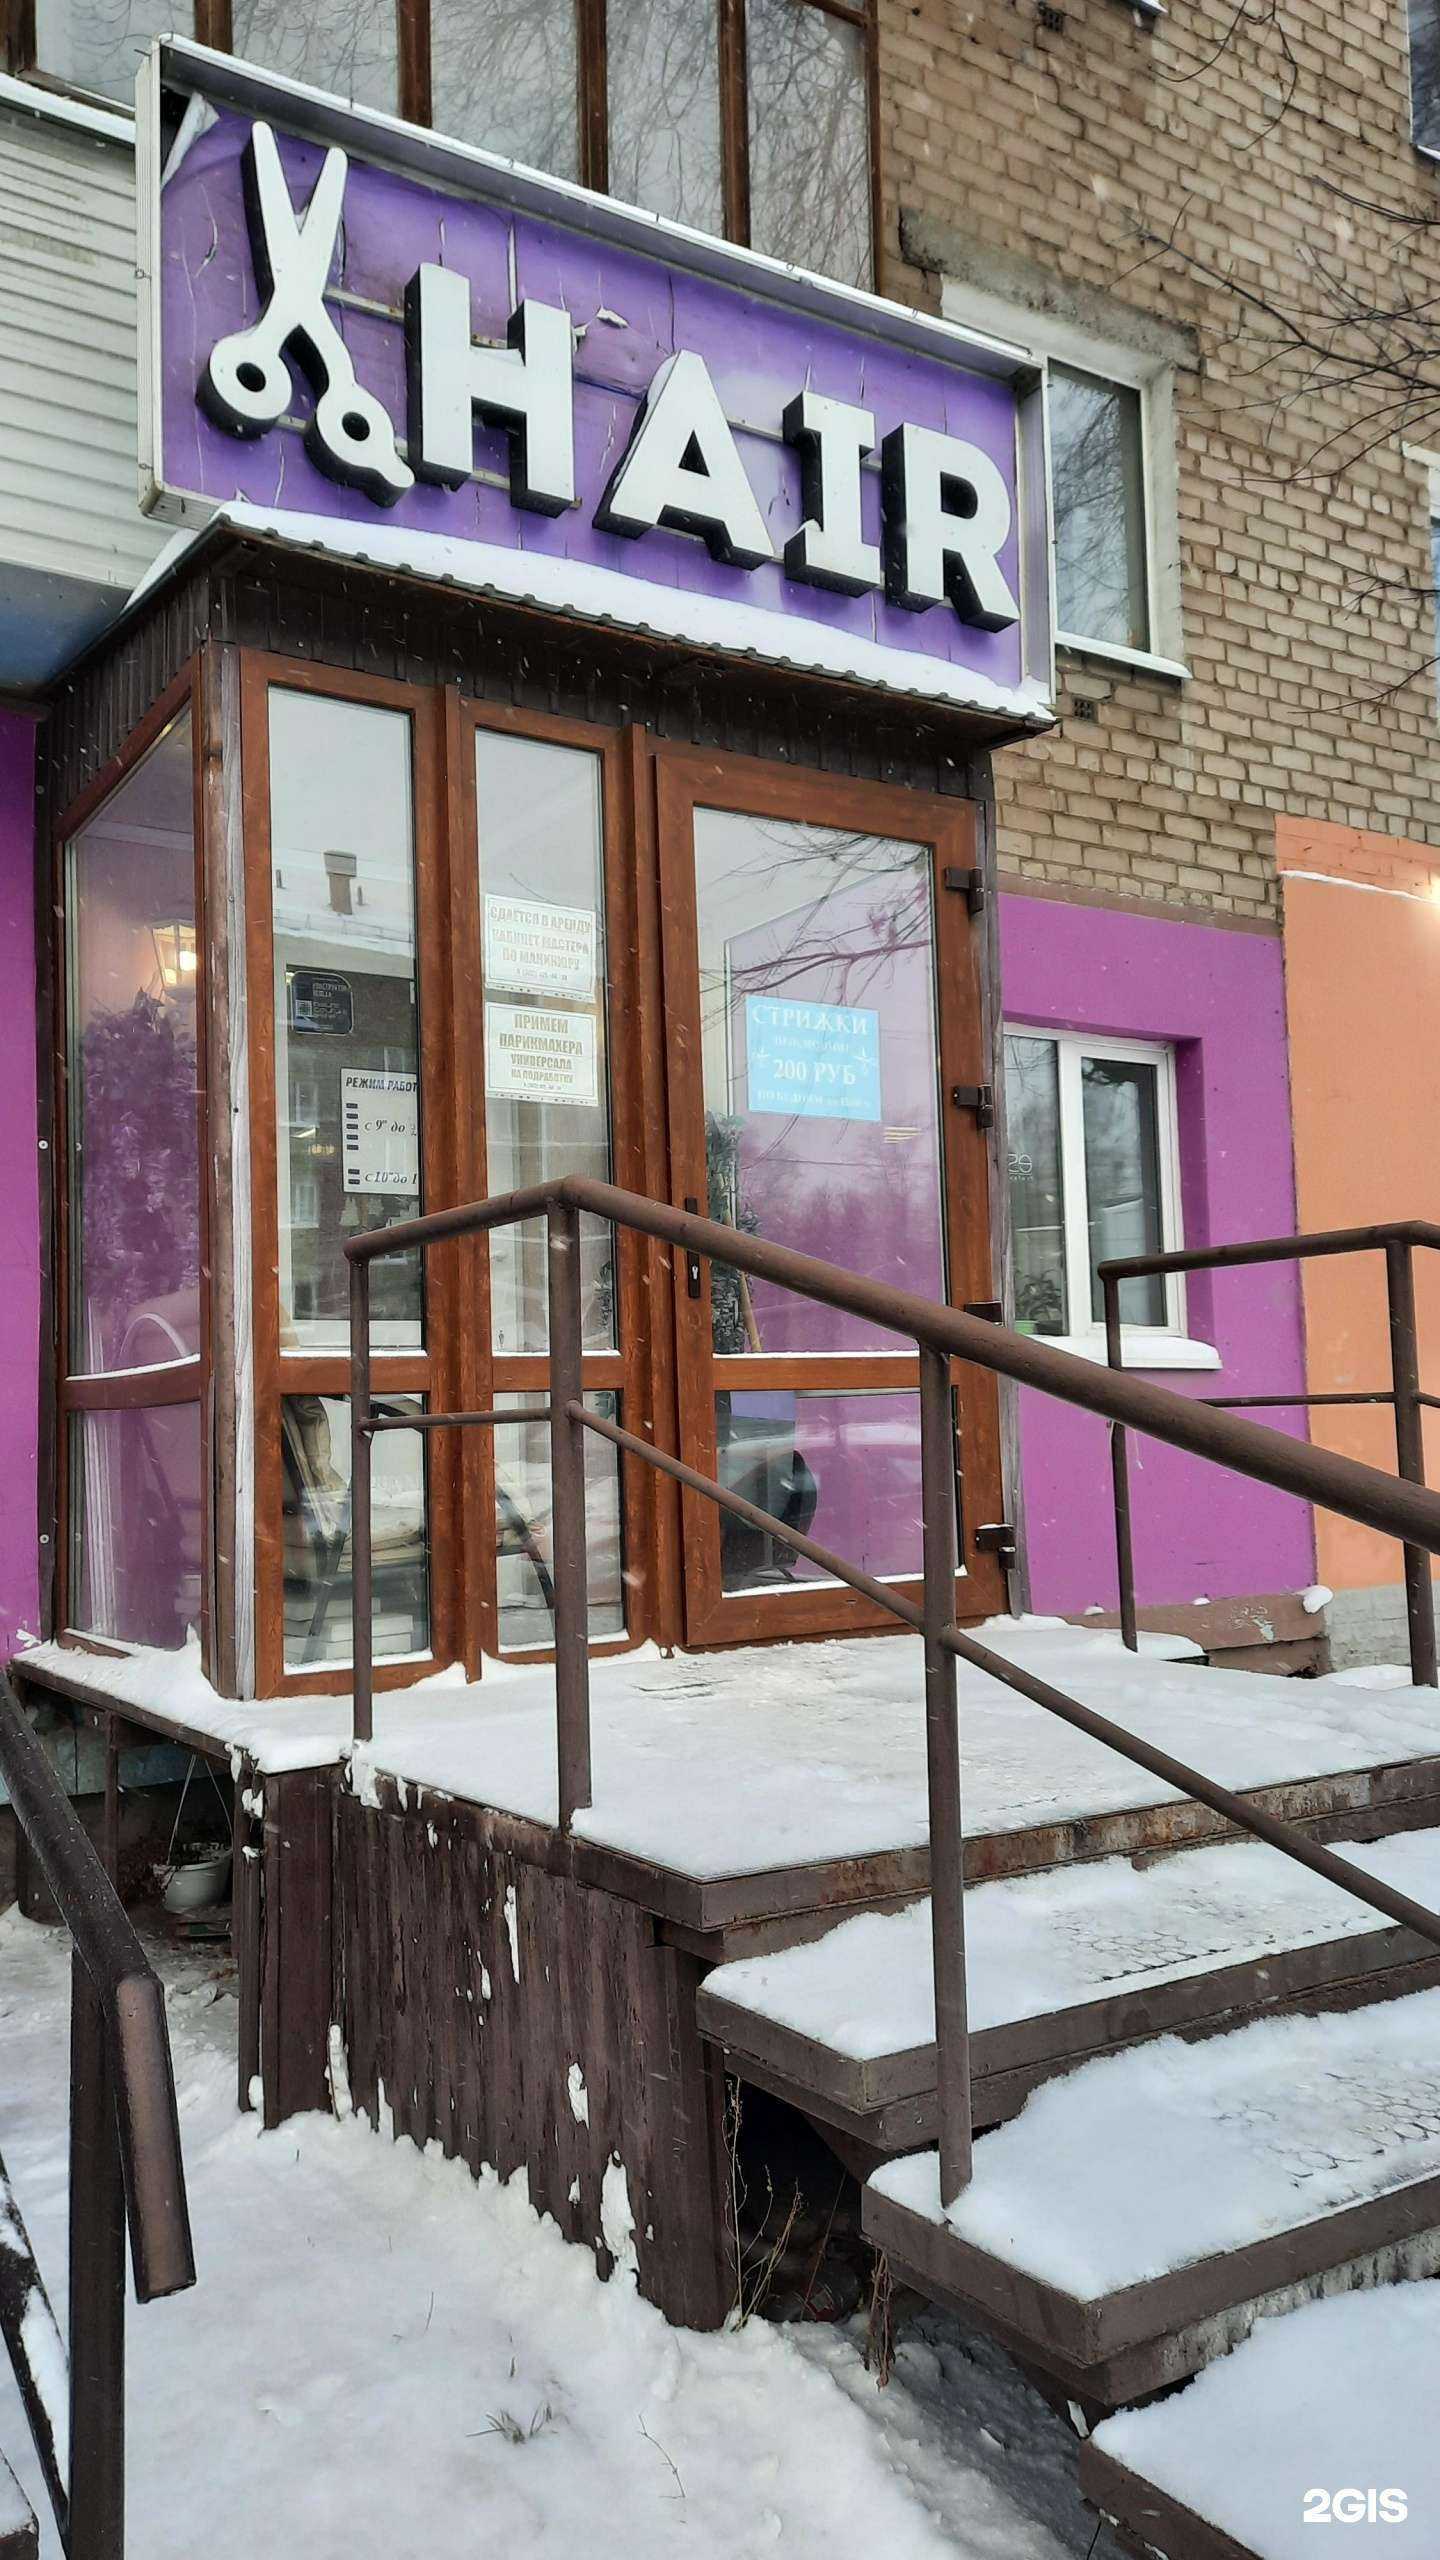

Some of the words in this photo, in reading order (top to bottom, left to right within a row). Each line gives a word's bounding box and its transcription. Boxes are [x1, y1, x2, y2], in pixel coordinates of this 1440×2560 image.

[404, 262, 1020, 632] HAIR
[514, 1013, 568, 1034] ПРИМЕМ
[752, 1004, 868, 1035] СТРИЖКИ
[499, 1033, 583, 1055] ПАРИКМАХЕРА
[511, 1053, 572, 1070] УНИВЕРСАЛА
[773, 1059, 807, 1081] 200
[814, 1061, 856, 1085] РУБ
[345, 1076, 385, 1091] РЕЖИМ
[387, 1079, 418, 1093] РАБОТ
